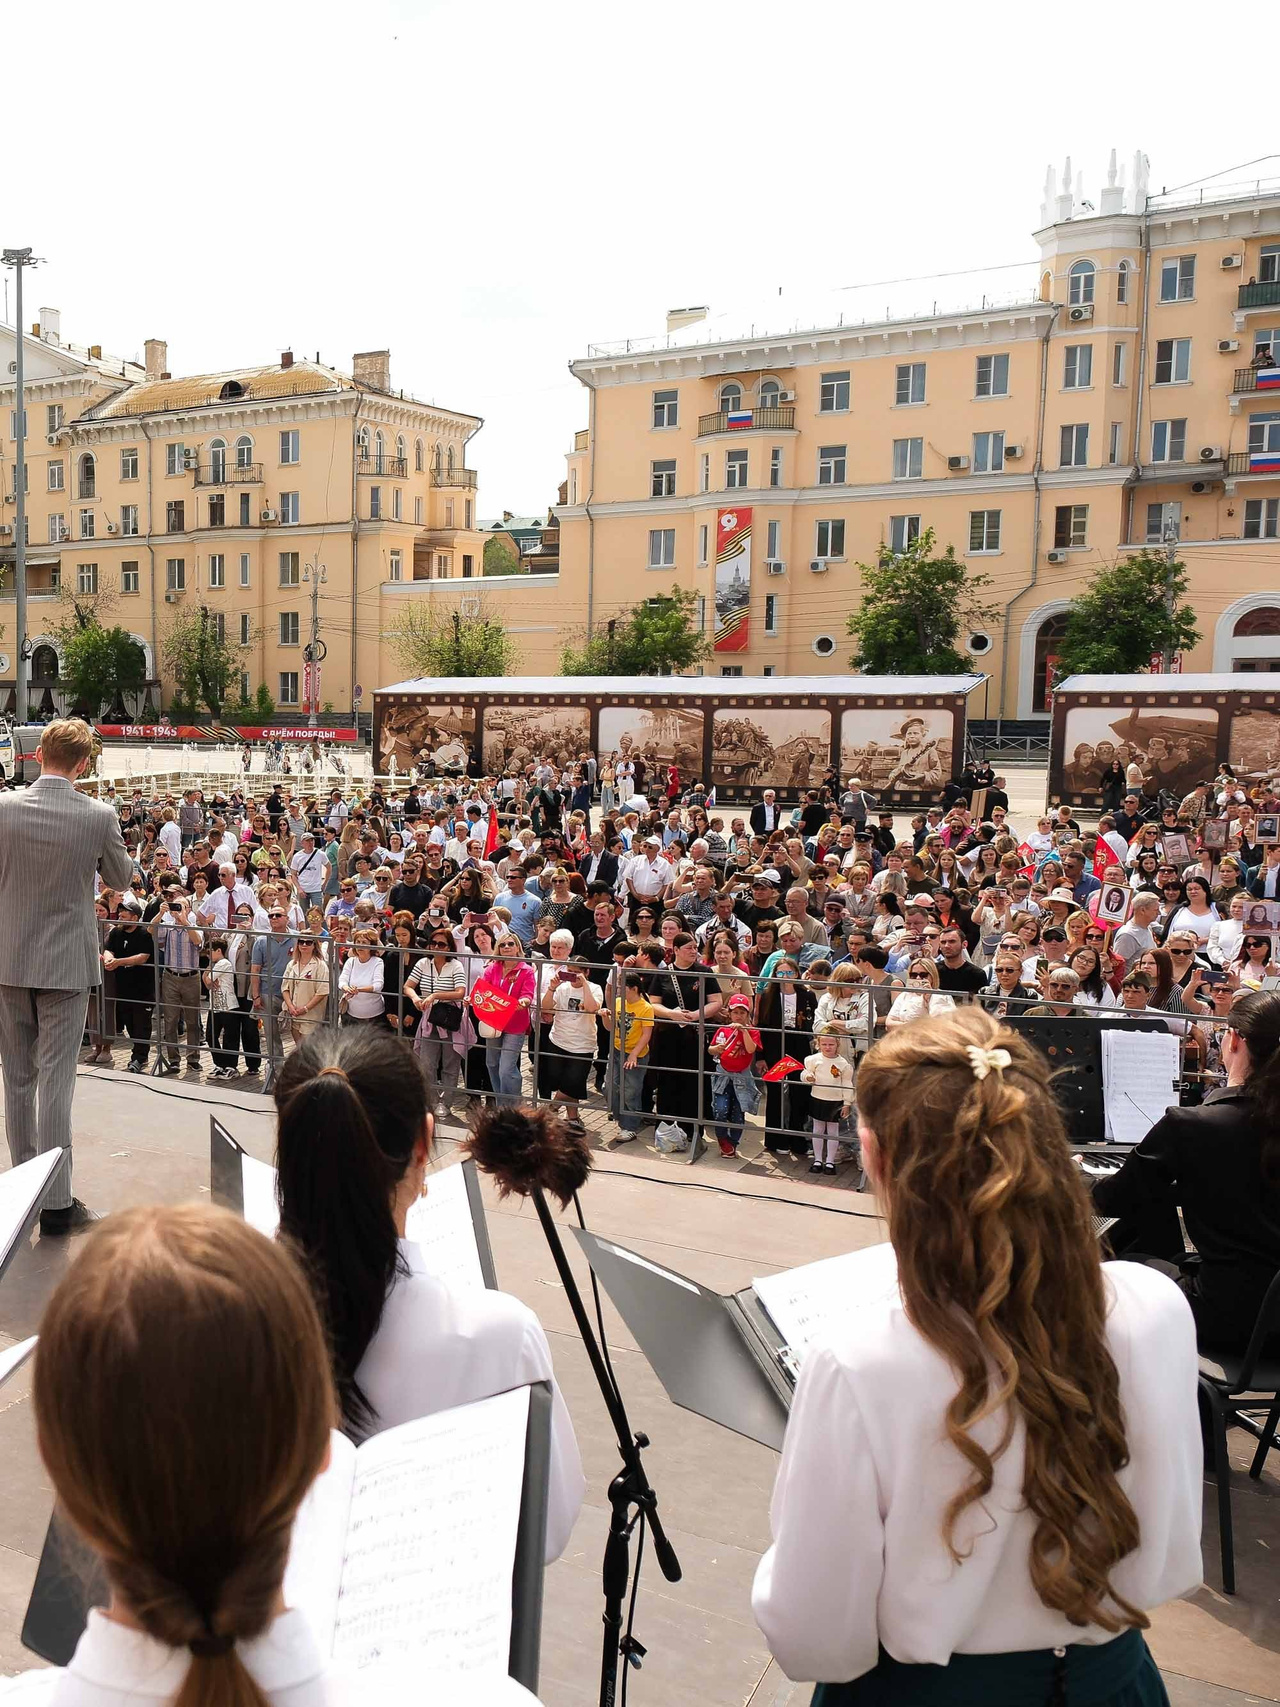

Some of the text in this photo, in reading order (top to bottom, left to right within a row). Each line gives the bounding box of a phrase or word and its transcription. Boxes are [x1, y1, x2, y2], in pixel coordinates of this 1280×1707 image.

[121, 725, 144, 736] 1941
[153, 726, 178, 737] 1945
[269, 728, 294, 738] ДНЁМ
[295, 730, 336, 739] ПОБЕДЫ!
